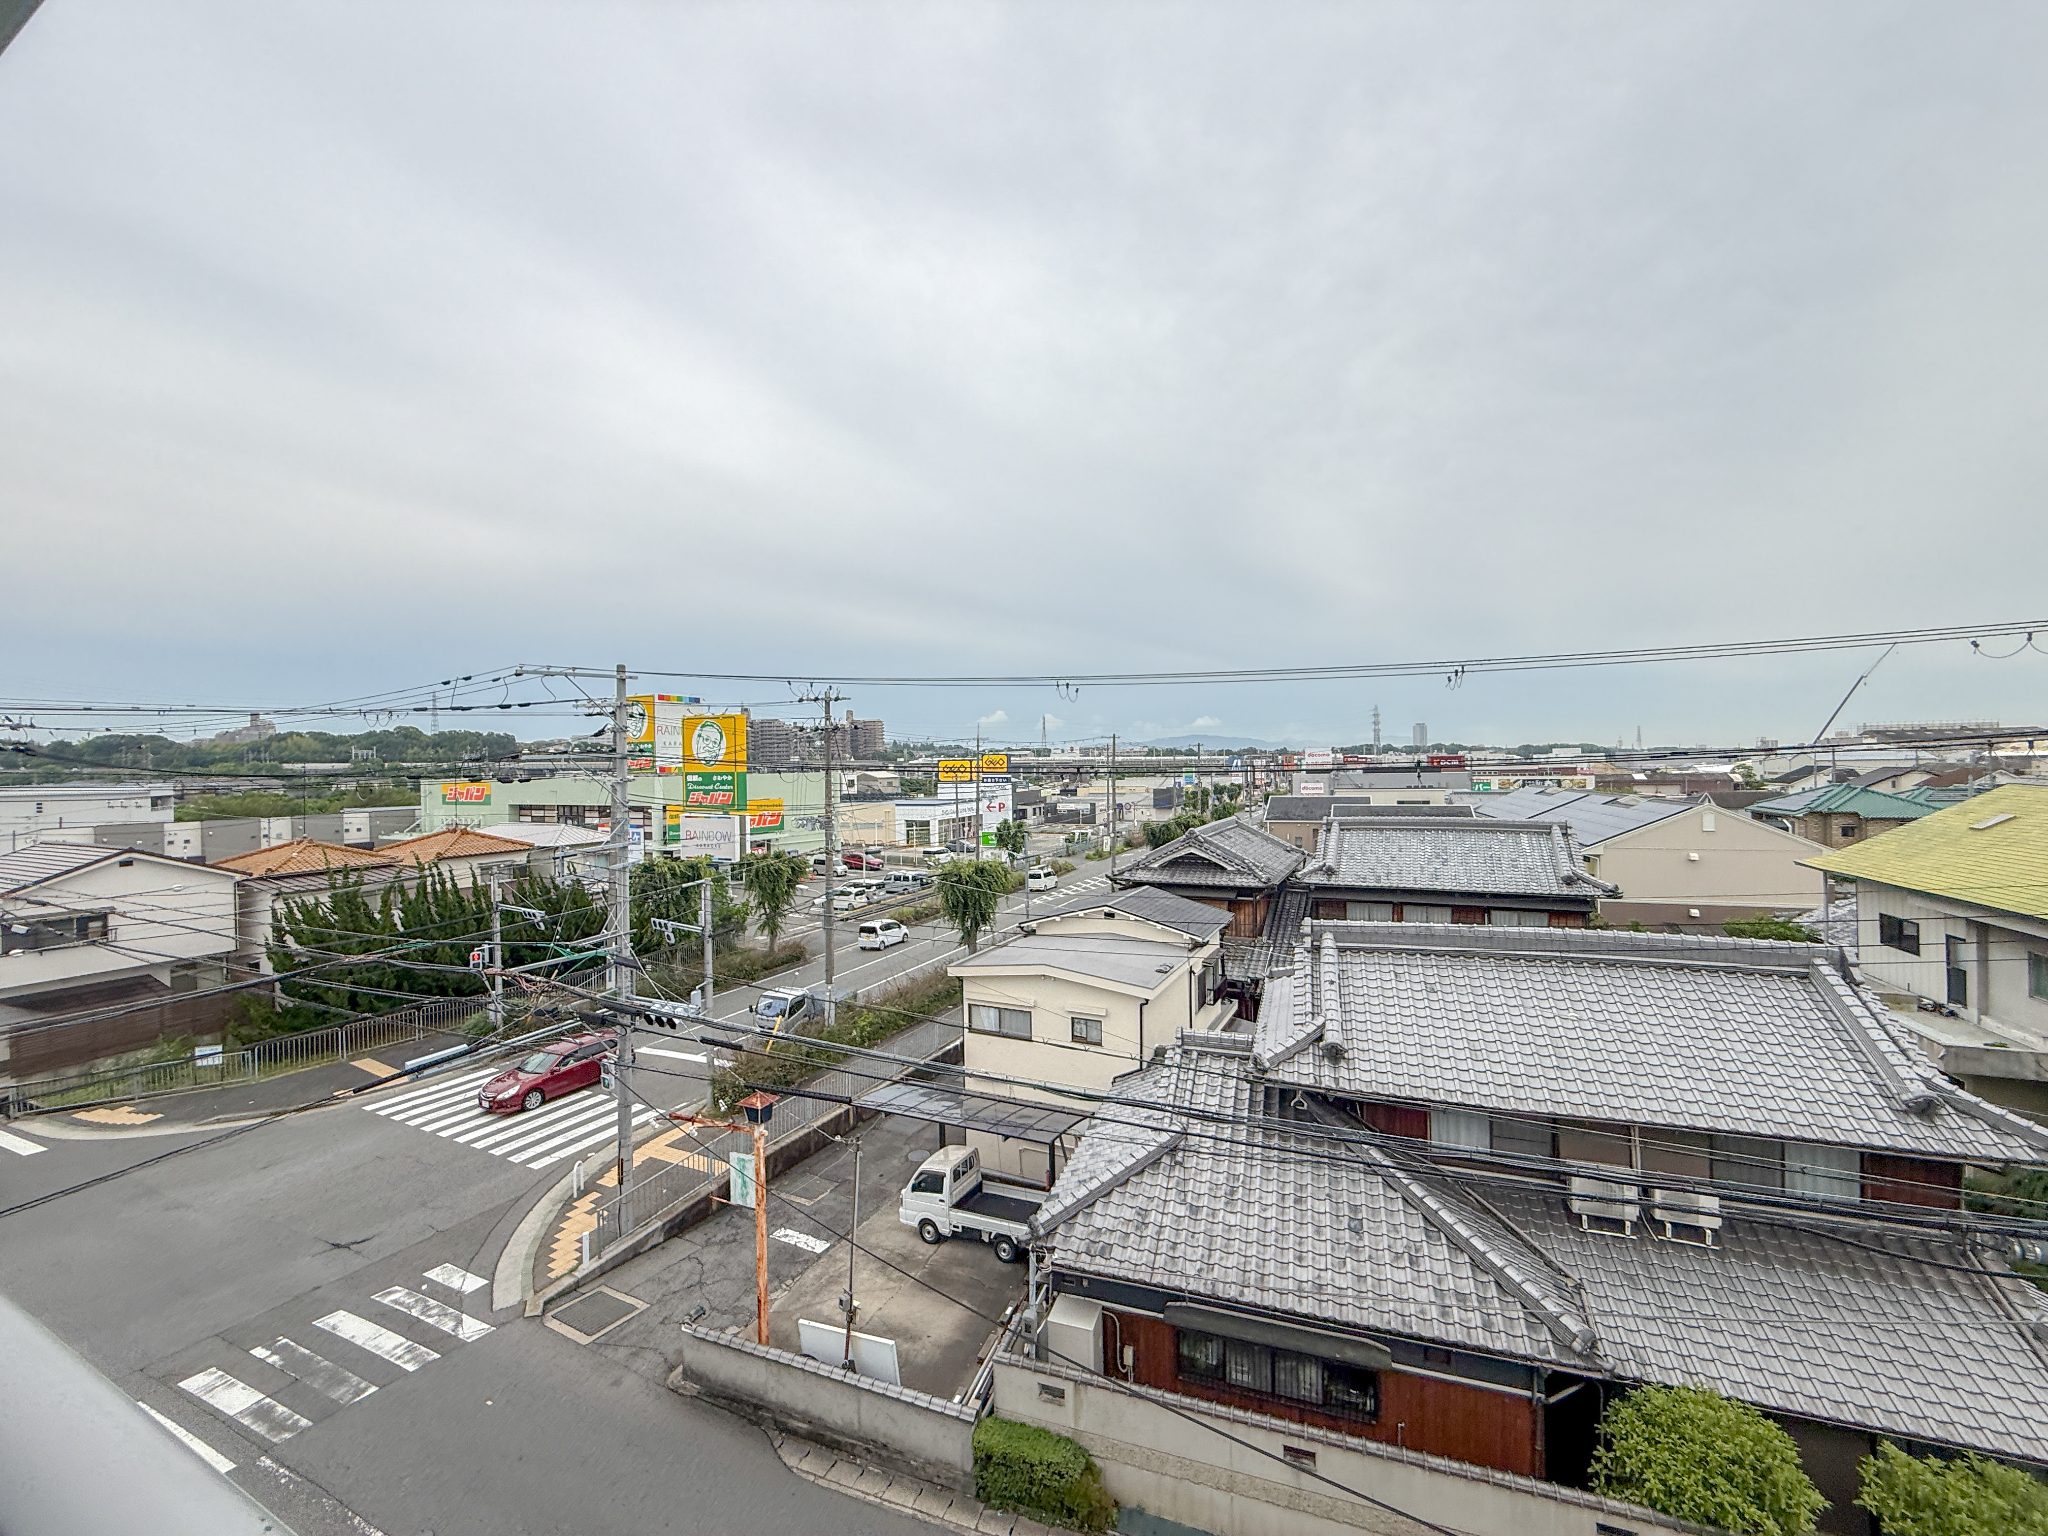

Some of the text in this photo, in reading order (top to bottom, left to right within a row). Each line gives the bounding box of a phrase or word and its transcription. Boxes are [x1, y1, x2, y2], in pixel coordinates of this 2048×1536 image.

[656, 725, 683, 736] RAIN
[446, 786, 487, 802] ジャパン
[687, 791, 734, 805] ジャパン
[998, 802, 1006, 813] P
[685, 829, 732, 842] RAINBOW
